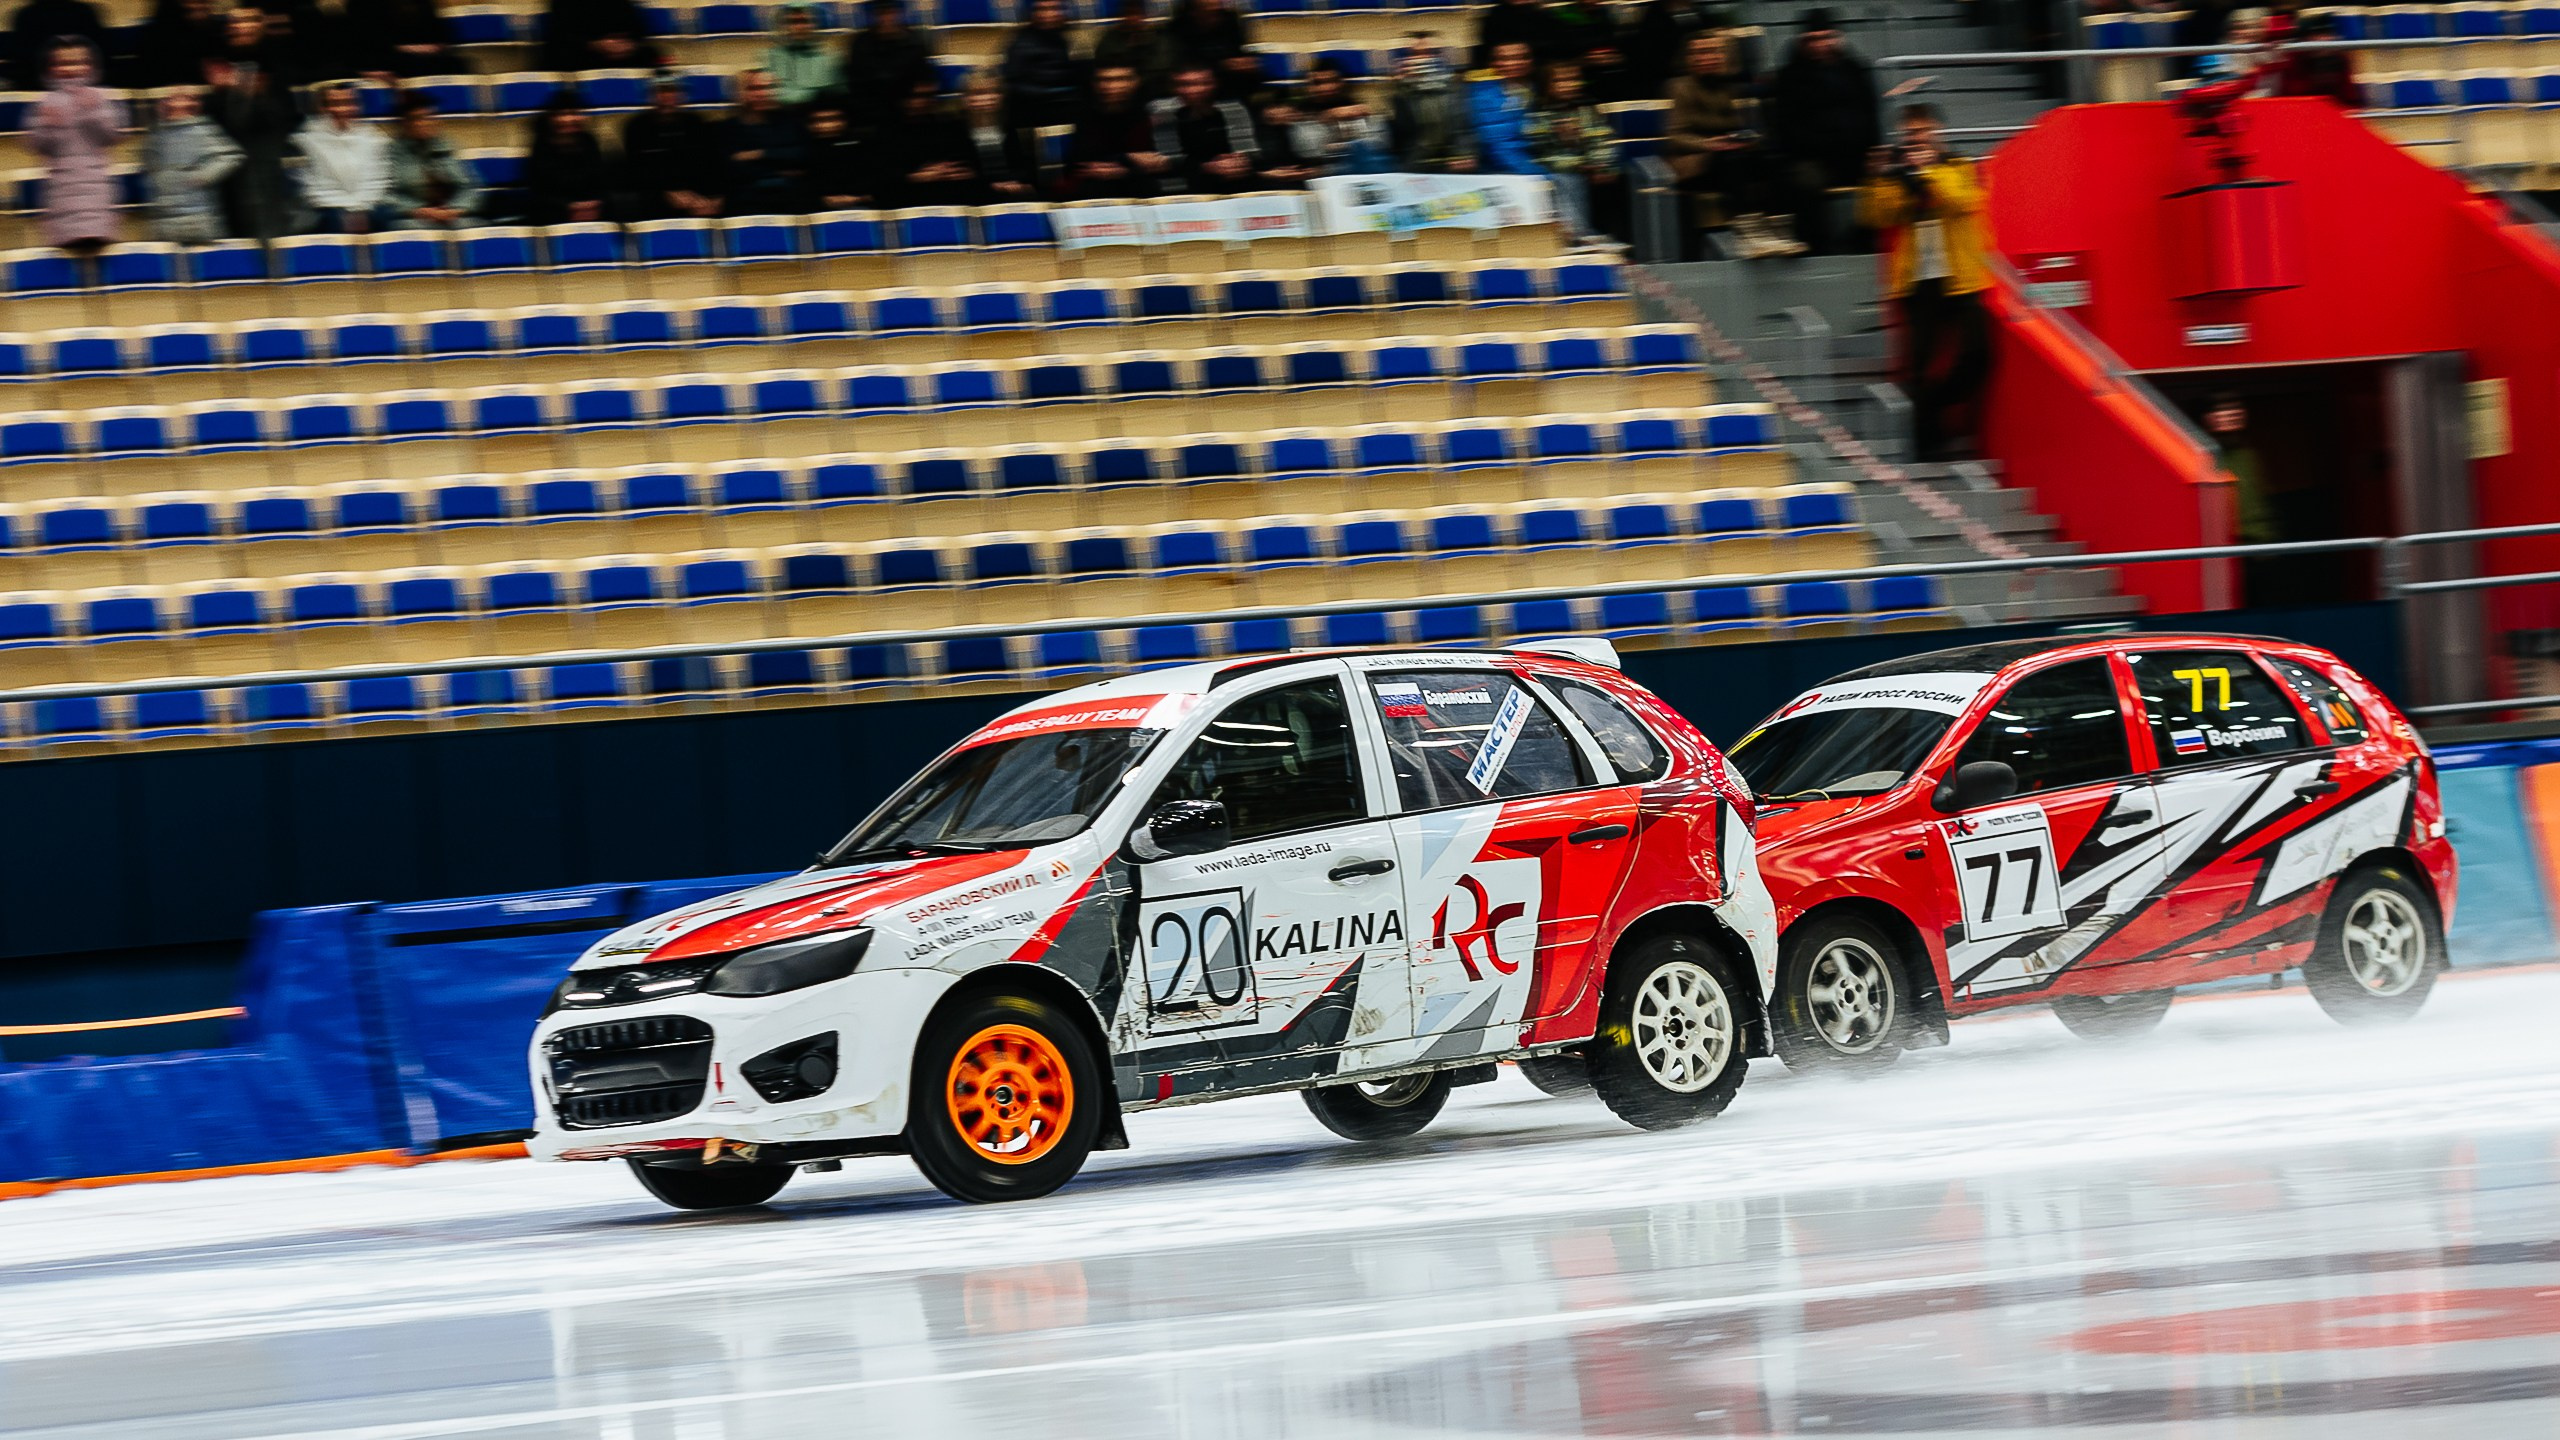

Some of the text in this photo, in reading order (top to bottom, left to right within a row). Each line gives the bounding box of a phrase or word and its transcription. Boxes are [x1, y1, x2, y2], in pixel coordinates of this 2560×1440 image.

[1422, 687, 1493, 708] Барановский
[1860, 690, 1906, 700] КРОСС
[1905, 690, 1966, 704] РОССИИ
[2172, 667, 2230, 712] 77
[1091, 708, 1148, 722] TEAM
[1472, 689, 1519, 785] МАСТЕР
[2205, 725, 2287, 747] Воронин
[1194, 842, 1332, 875] www.lada-image.ru
[905, 876, 1021, 923] БАРАНОВСКИЙ
[1964, 846, 2042, 923] 77
[904, 910, 1037, 961] LADA IMAGE RALLY TEAM
[1255, 909, 1403, 962] KALINA
[1151, 906, 1247, 1015] 20
